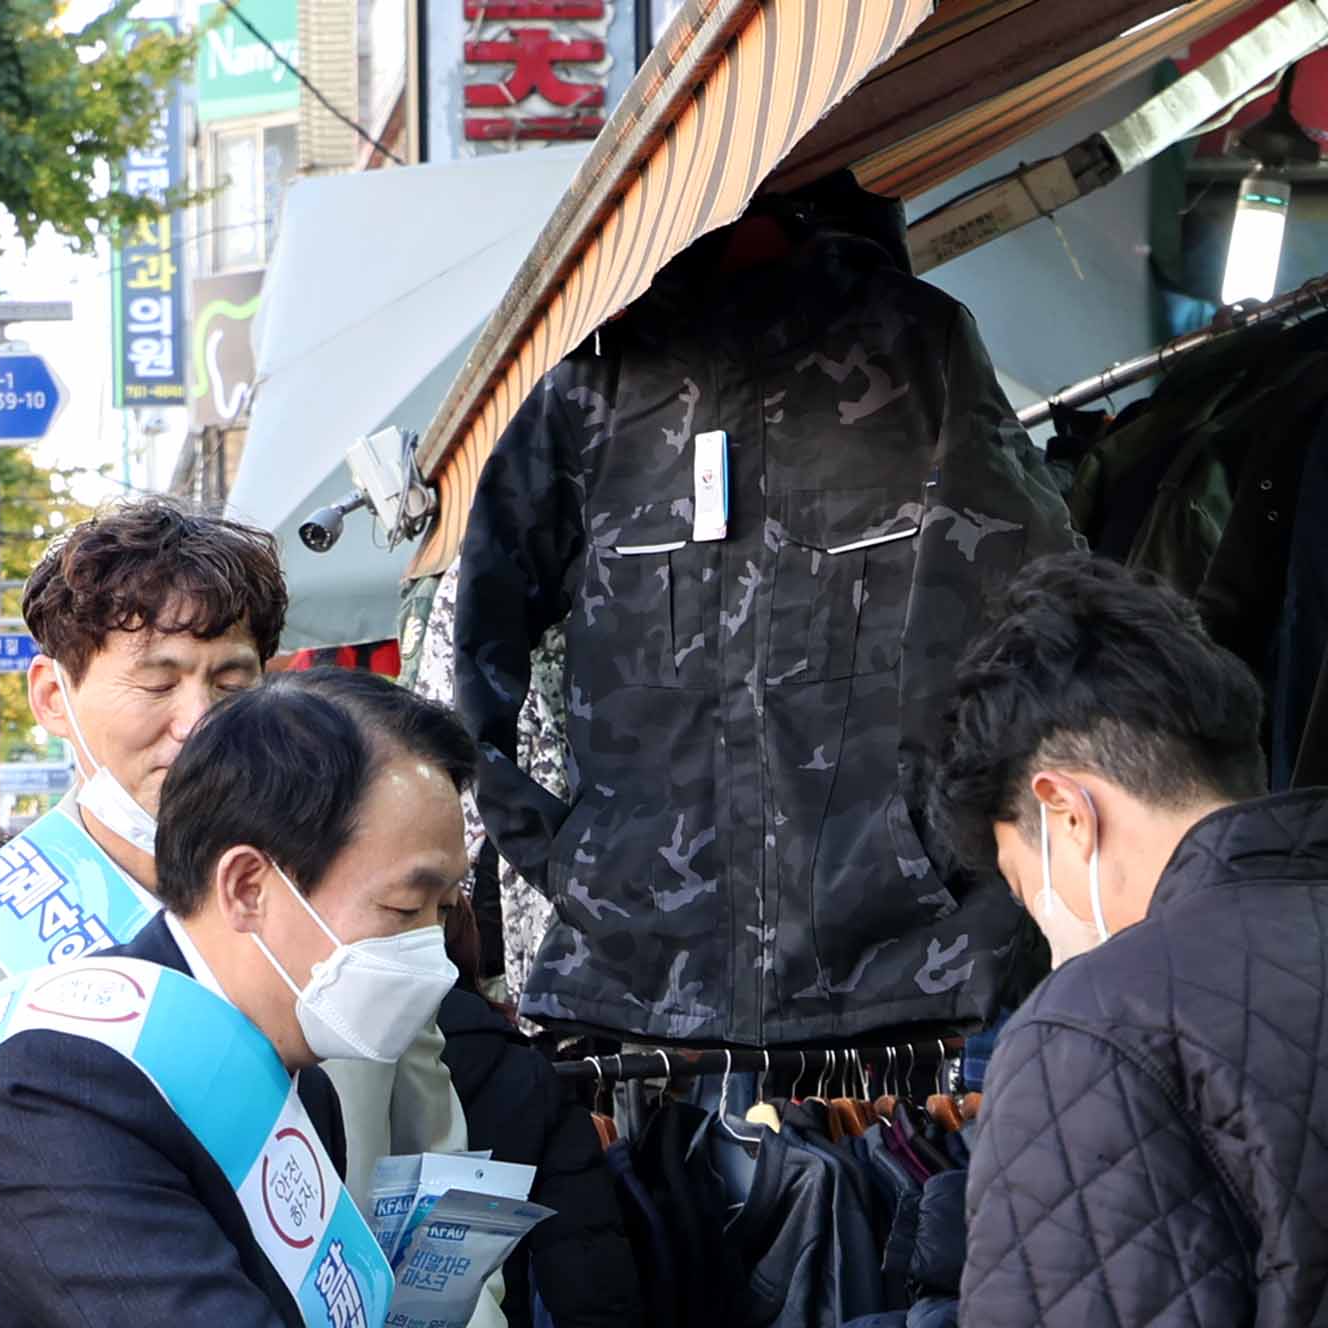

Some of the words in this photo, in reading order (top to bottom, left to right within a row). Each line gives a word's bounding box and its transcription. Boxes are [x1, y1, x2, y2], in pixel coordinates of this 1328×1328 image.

[38, 890, 121, 966] 4일
[274, 1154, 303, 1203] 안전
[400, 1270, 449, 1293] 마스크
[410, 1250, 472, 1277] 비말차단
